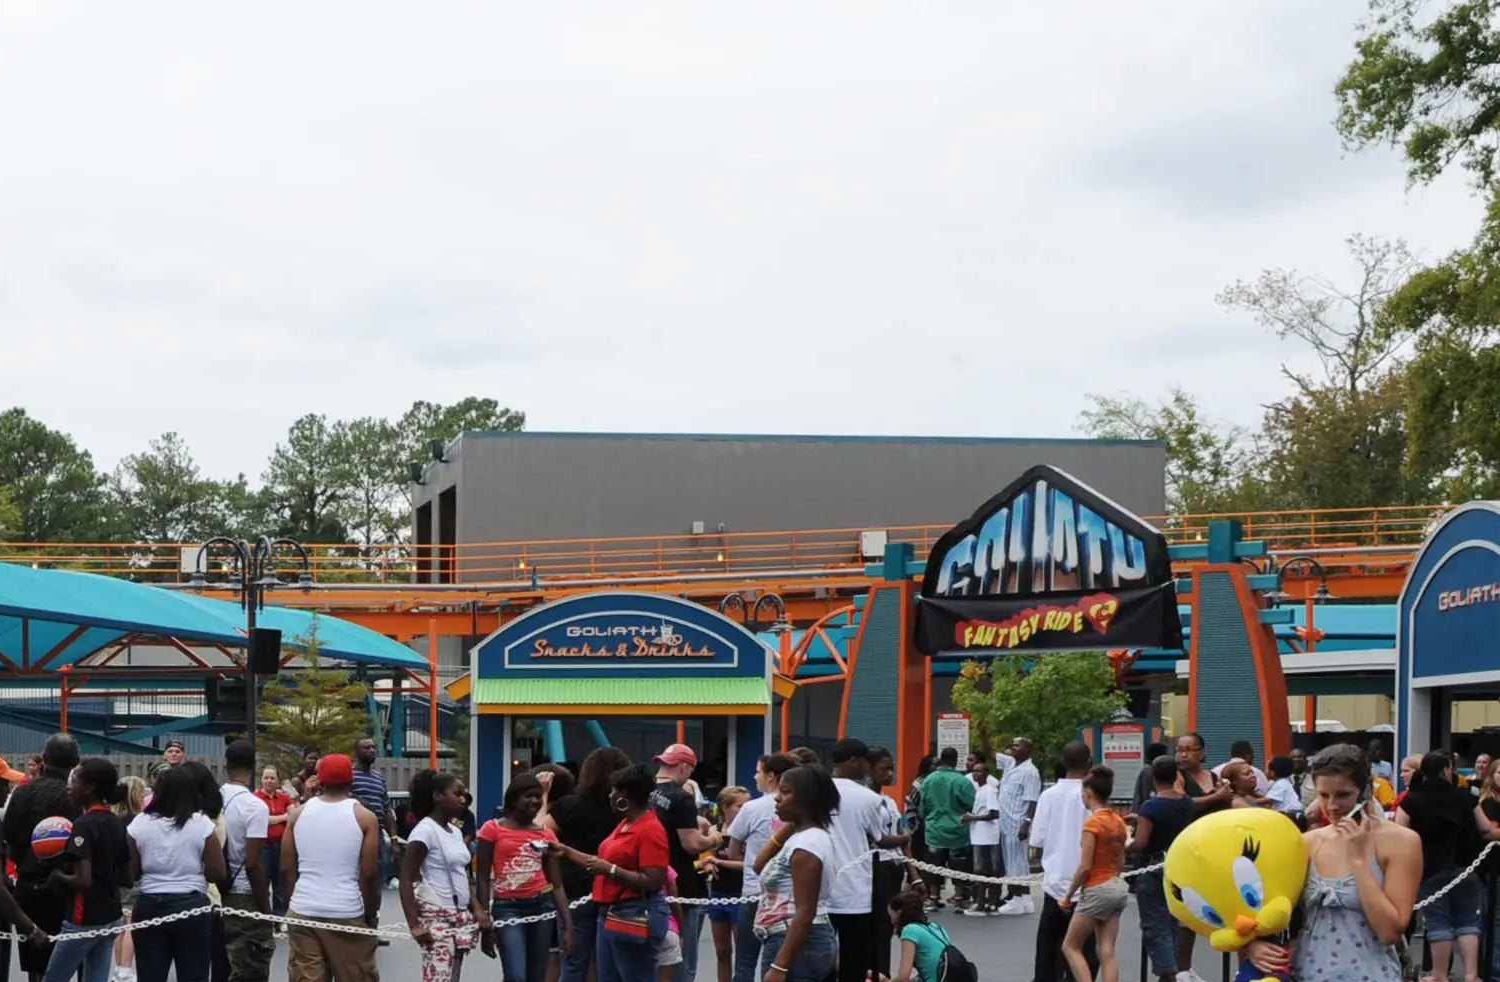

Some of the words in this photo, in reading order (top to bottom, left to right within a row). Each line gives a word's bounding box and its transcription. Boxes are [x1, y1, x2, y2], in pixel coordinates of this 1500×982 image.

[566, 626, 658, 637] GOLIATH
[963, 612, 1040, 649] FANTASY
[1042, 608, 1084, 634] RIDE
[530, 639, 612, 658] Snacks
[615, 642, 628, 658] &
[629, 635, 716, 658] Drinks
